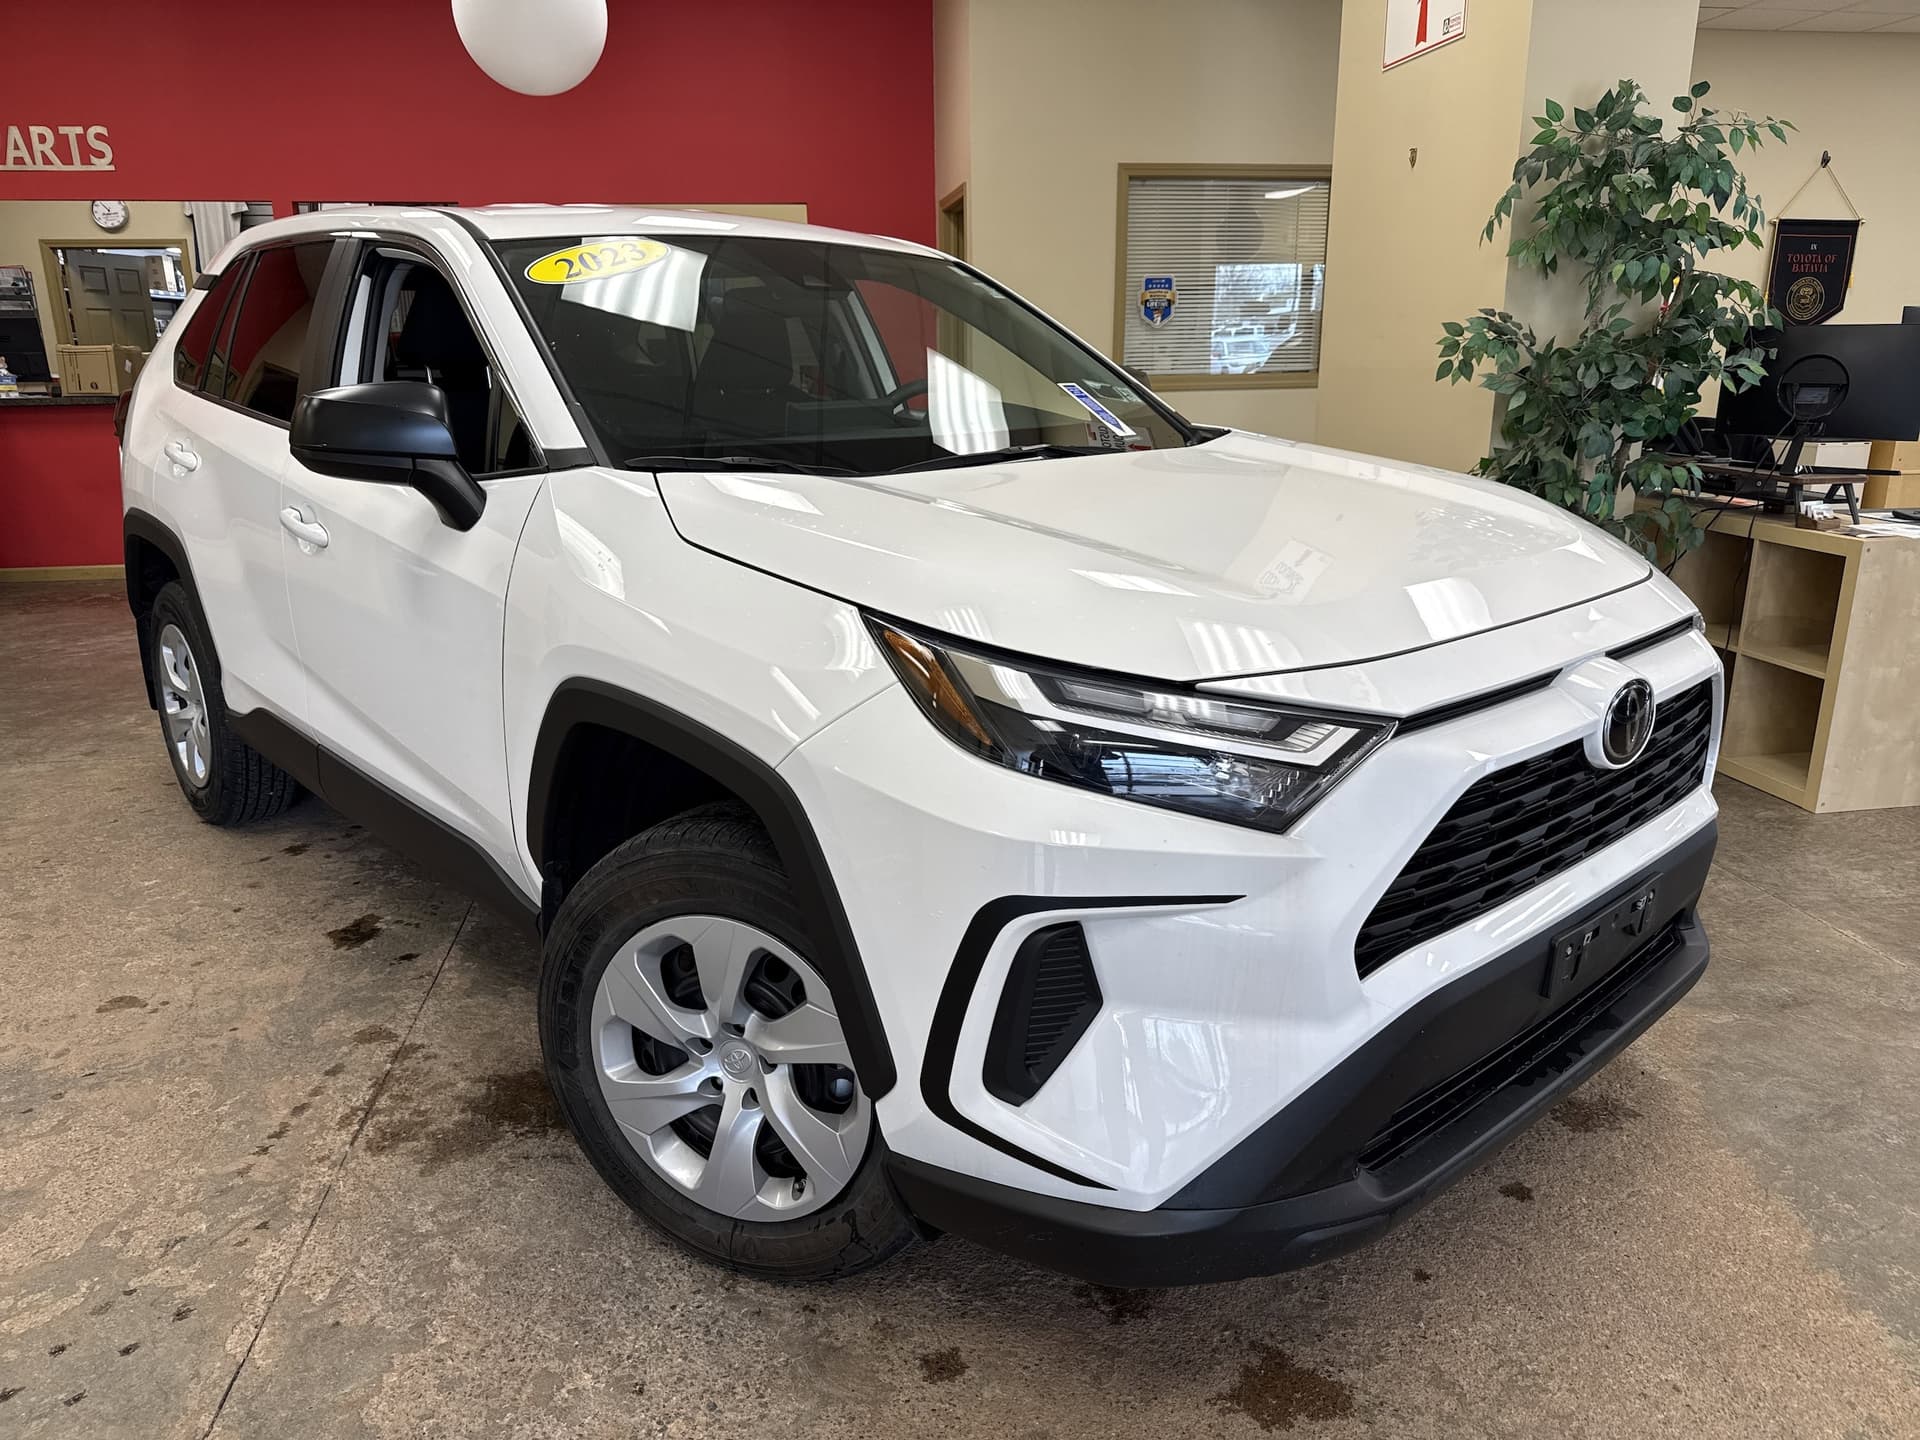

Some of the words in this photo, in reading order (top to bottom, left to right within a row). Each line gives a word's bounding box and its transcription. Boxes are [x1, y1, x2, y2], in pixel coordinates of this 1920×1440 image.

[553, 242, 647, 280] 2023
[1786, 254, 1822, 263] TOYOTA
[1825, 254, 1839, 263] OF
[1791, 264, 1828, 273] BATAVIA
